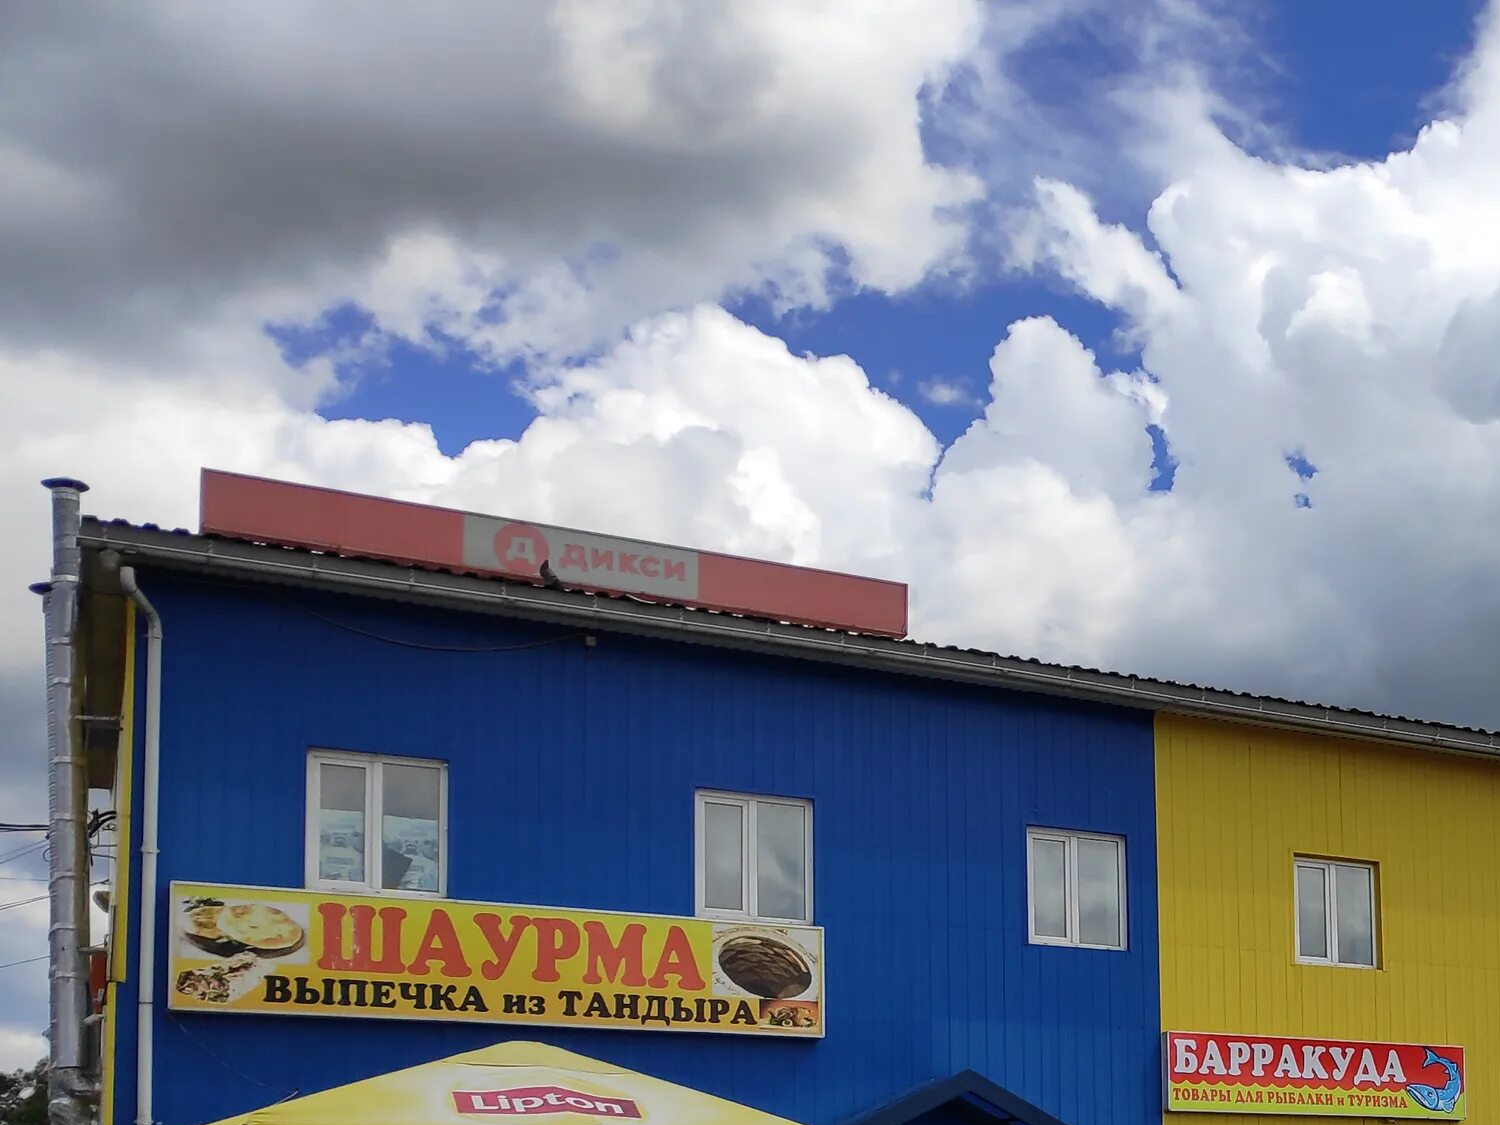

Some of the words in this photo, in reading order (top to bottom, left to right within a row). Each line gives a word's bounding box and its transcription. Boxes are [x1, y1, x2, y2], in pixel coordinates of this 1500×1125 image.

[559, 543, 687, 582] ДИКСИ
[317, 902, 706, 991] ШАУРМА
[262, 974, 490, 1013] ВЫПЕЧКА
[502, 993, 546, 1015] из
[557, 990, 758, 1026] ТАНДЫРА
[1173, 1038, 1407, 1087] БАРРАКУДА
[470, 1092, 625, 1114] Lipton
[1173, 1087, 1232, 1103] ТОВАРЫ
[1234, 1089, 1264, 1105] ДЛЯ
[1267, 1092, 1335, 1107] РЫБАЛКИ
[1346, 1094, 1409, 1109] ТУРИЗМА
